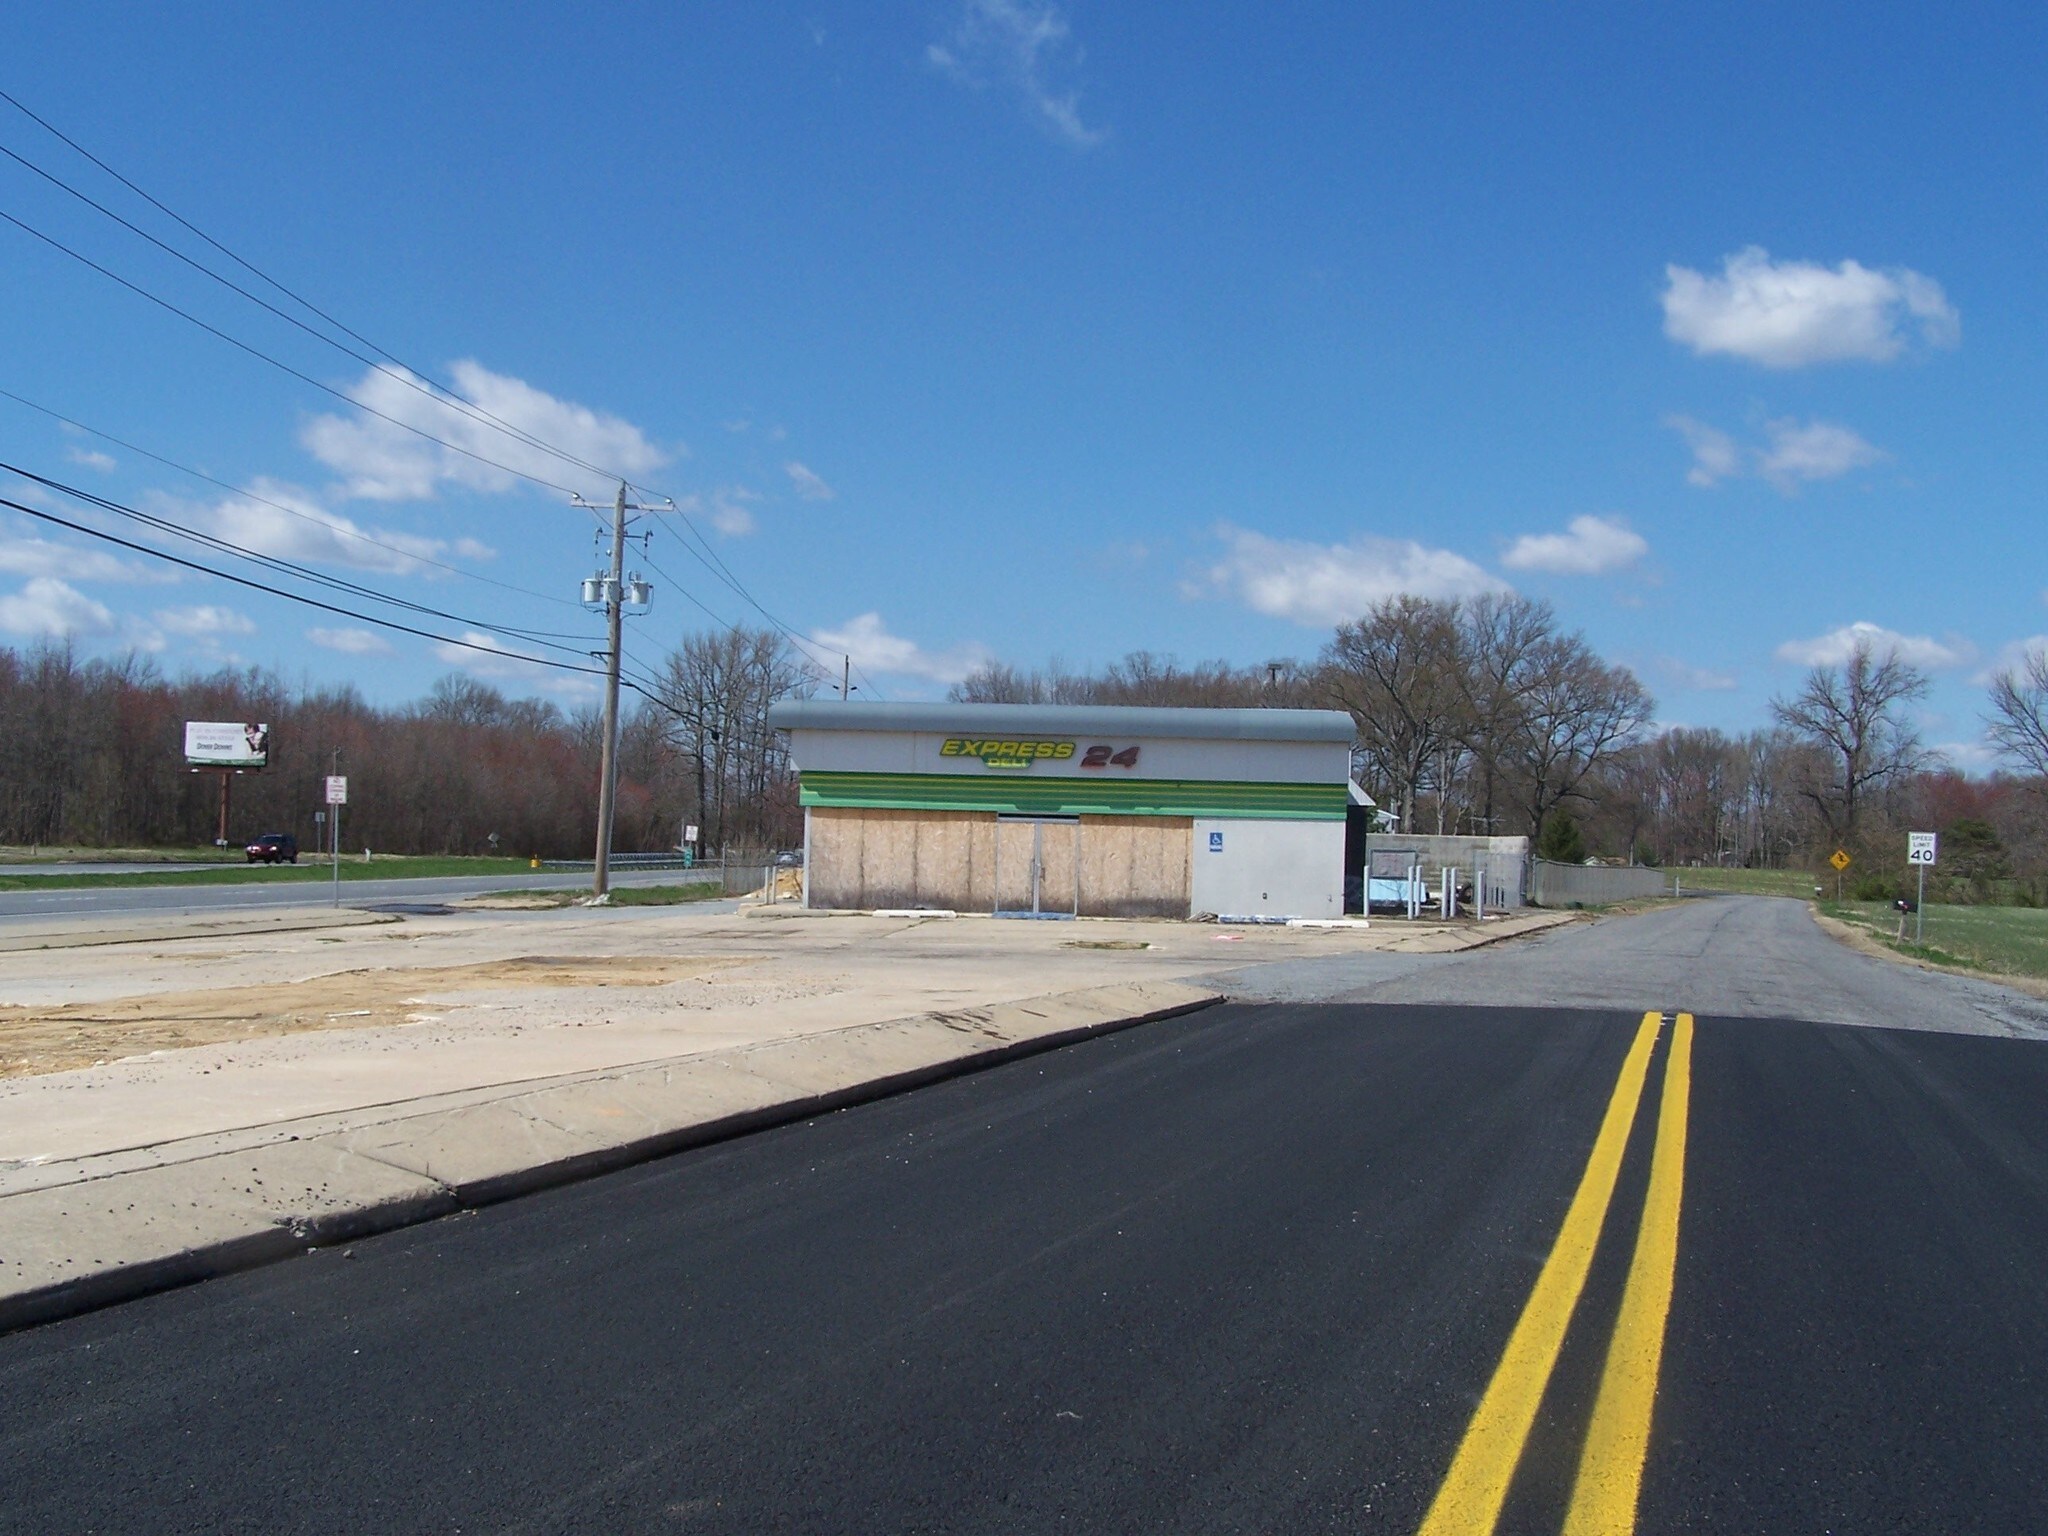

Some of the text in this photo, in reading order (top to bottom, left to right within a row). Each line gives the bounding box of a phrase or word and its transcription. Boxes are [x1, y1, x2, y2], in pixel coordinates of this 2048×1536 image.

[940, 739, 1141, 769] EXPRESS 24
[1911, 850, 1932, 861] 40
